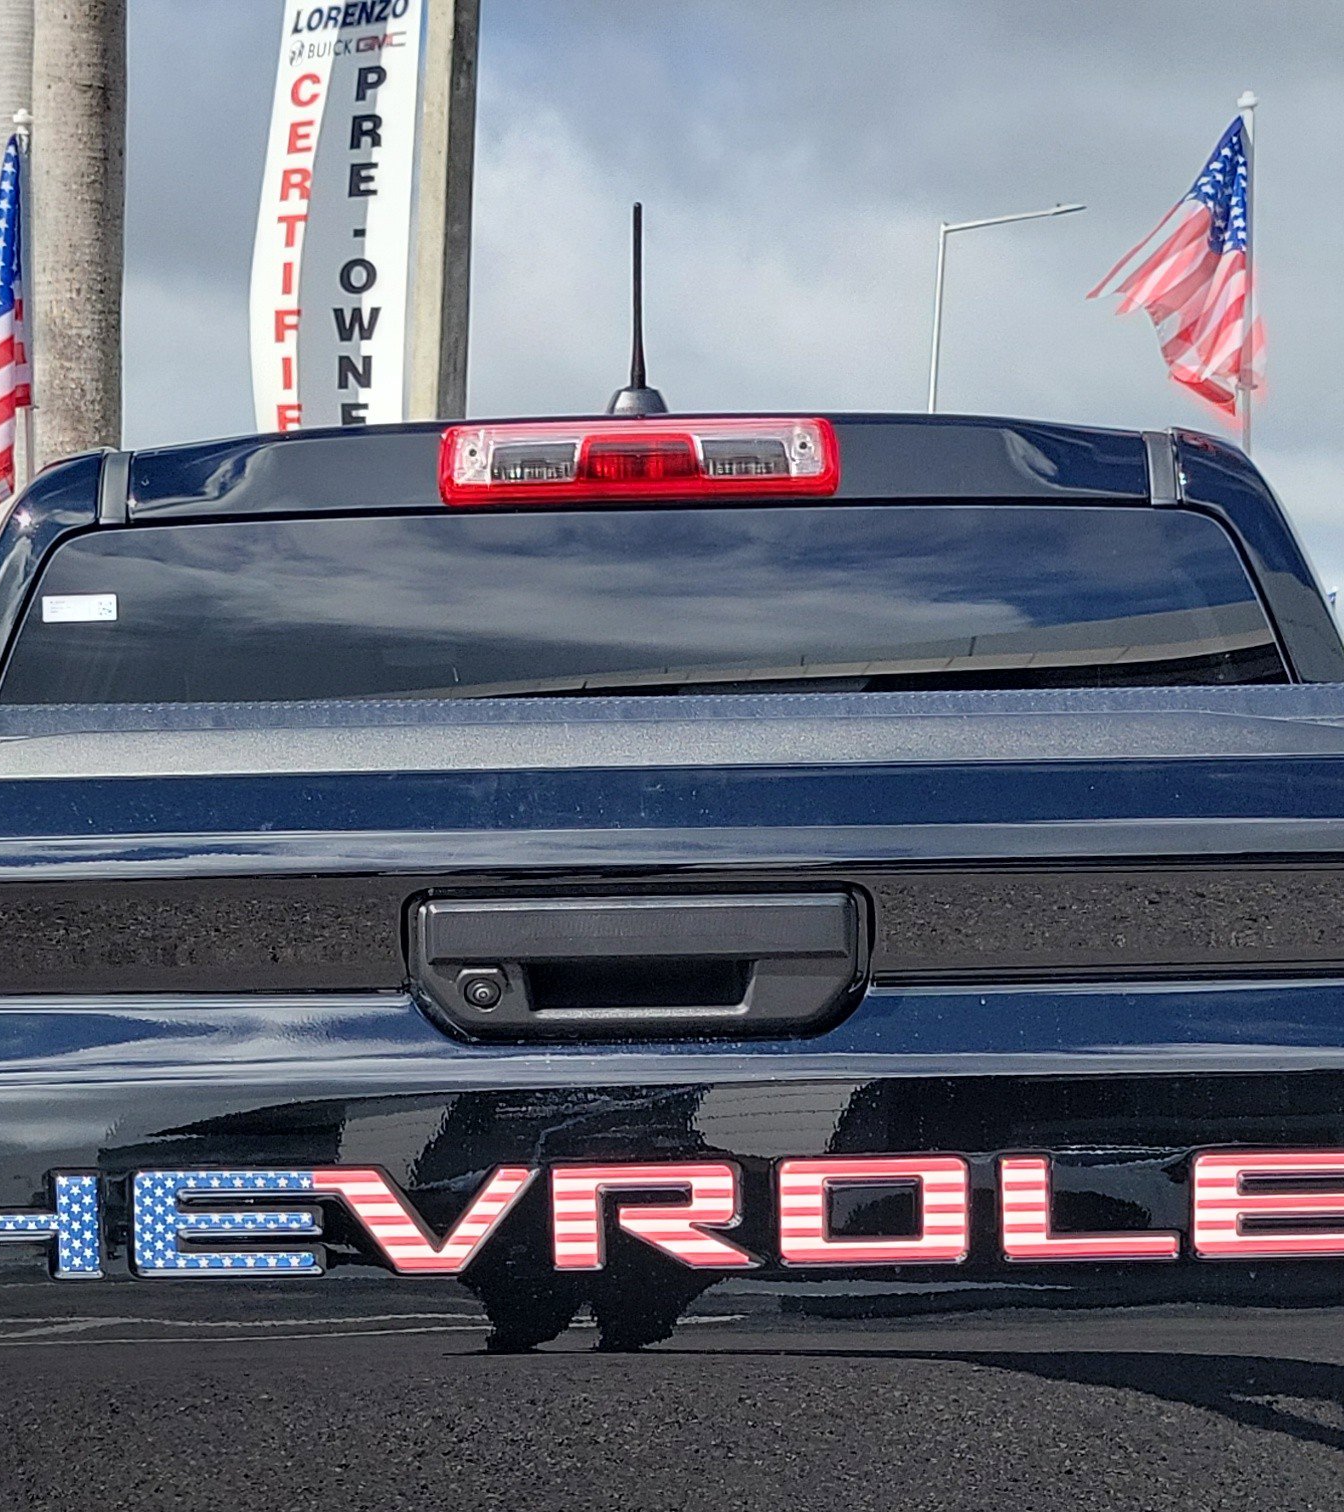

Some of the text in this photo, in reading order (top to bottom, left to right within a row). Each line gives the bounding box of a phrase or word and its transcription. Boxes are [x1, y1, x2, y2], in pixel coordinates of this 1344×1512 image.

[292, 0, 408, 34] LORENZO
[307, 31, 406, 59] BUICK GMC
